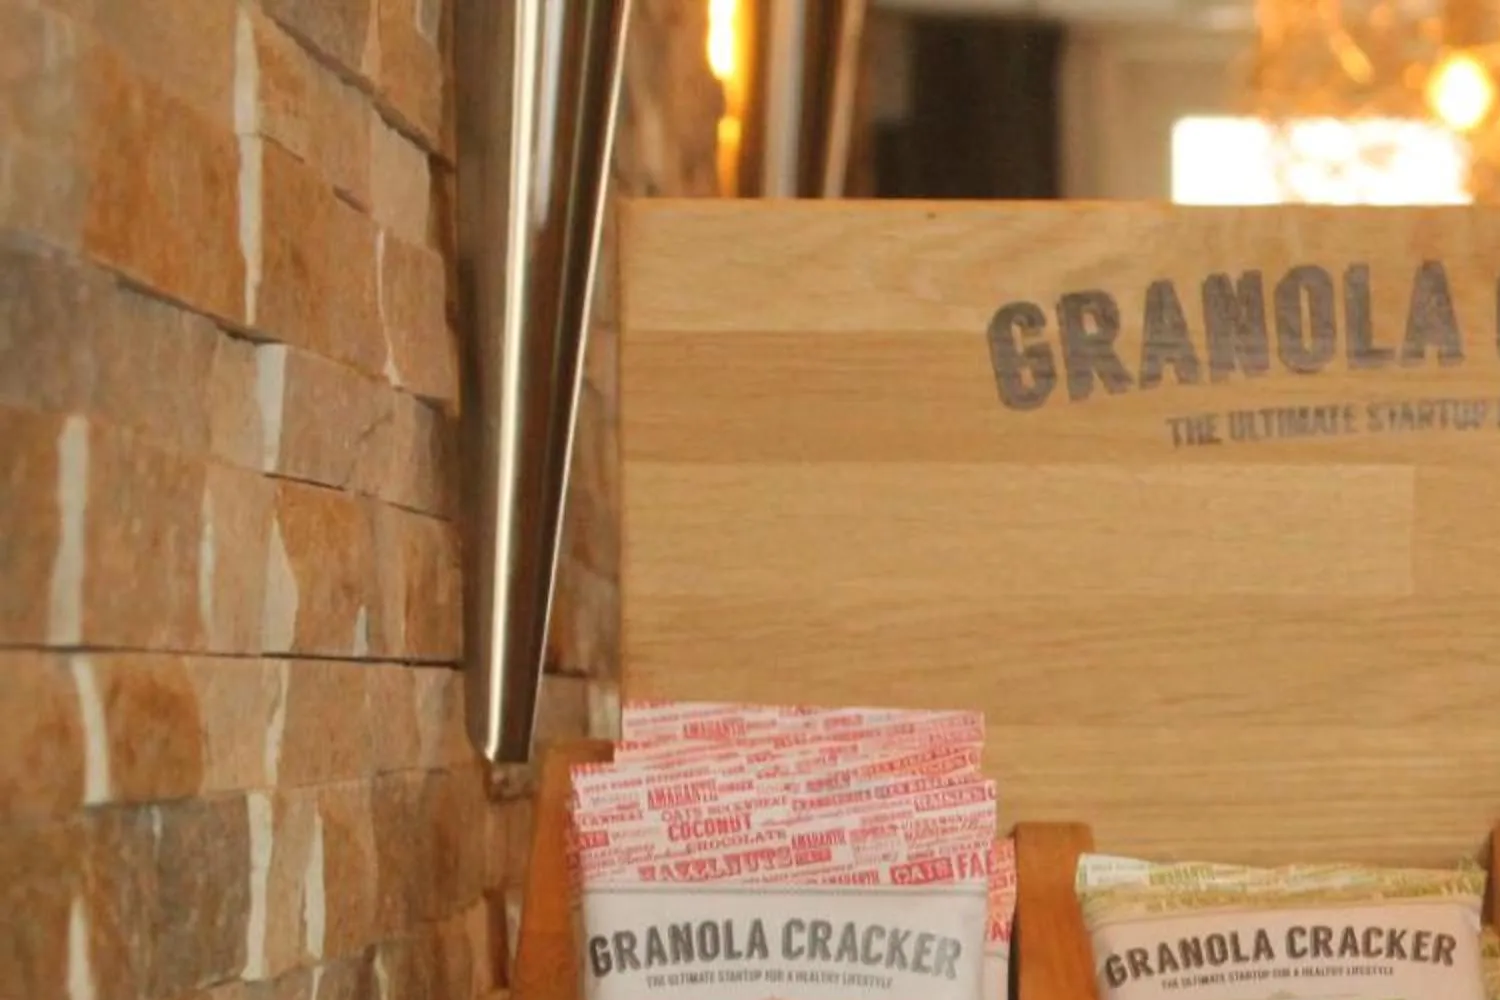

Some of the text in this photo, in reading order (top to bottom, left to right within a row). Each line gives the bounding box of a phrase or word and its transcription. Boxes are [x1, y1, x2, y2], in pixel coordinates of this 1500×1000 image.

[986, 259, 1464, 411] GRANOLA
[1165, 412, 1223, 449] THE
[1227, 403, 1358, 442] ULTIMATE
[1366, 398, 1492, 433] STARTUP
[668, 814, 752, 842] COCONUT
[589, 918, 962, 981] GRANOLA CRACKER
[1103, 925, 1457, 989] GRANOLA CRACKER
